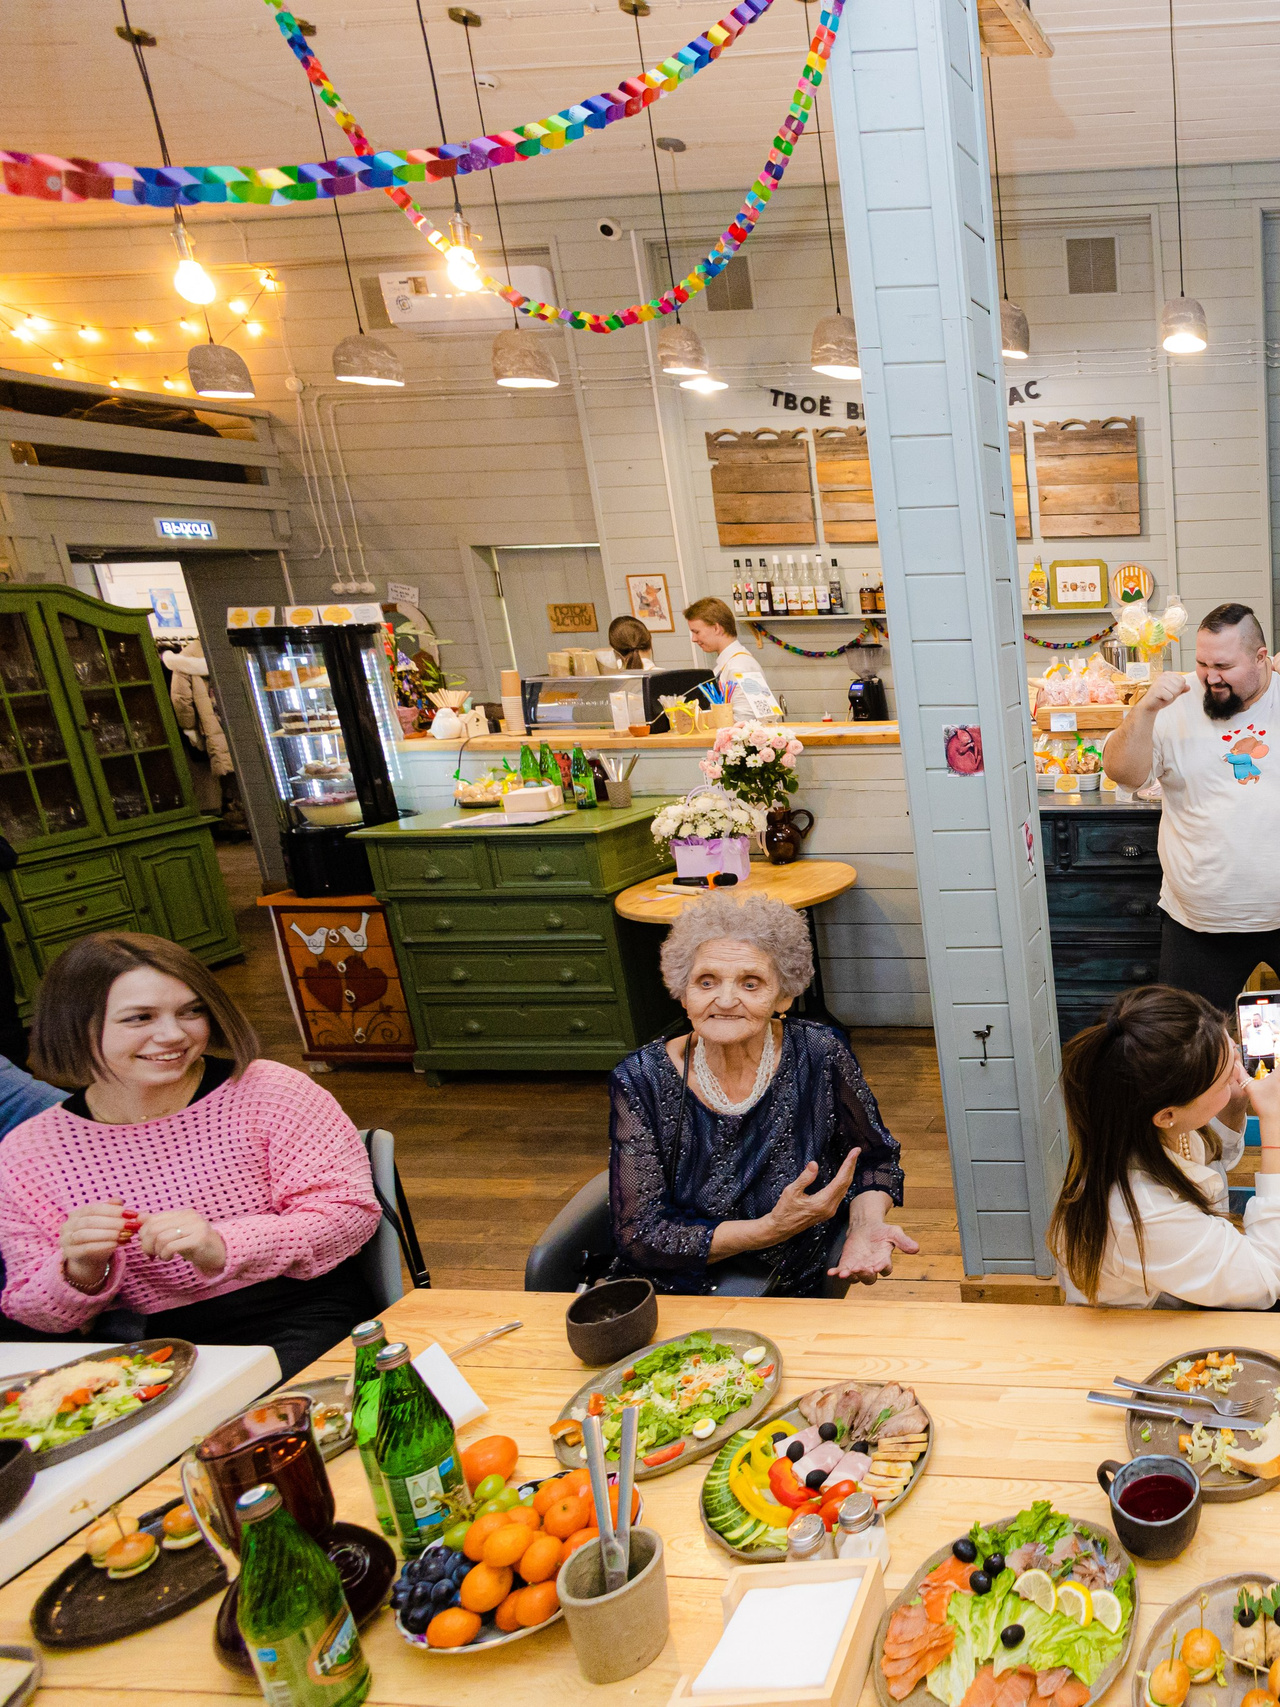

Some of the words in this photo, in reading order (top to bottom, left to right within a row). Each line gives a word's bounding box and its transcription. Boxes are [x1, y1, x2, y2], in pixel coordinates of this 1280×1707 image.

[769, 388, 831, 417] ТВОЁ
[846, 402, 866, 421] В
[1008, 380, 1042, 406] АС
[161, 521, 212, 536] ВЫХОД
